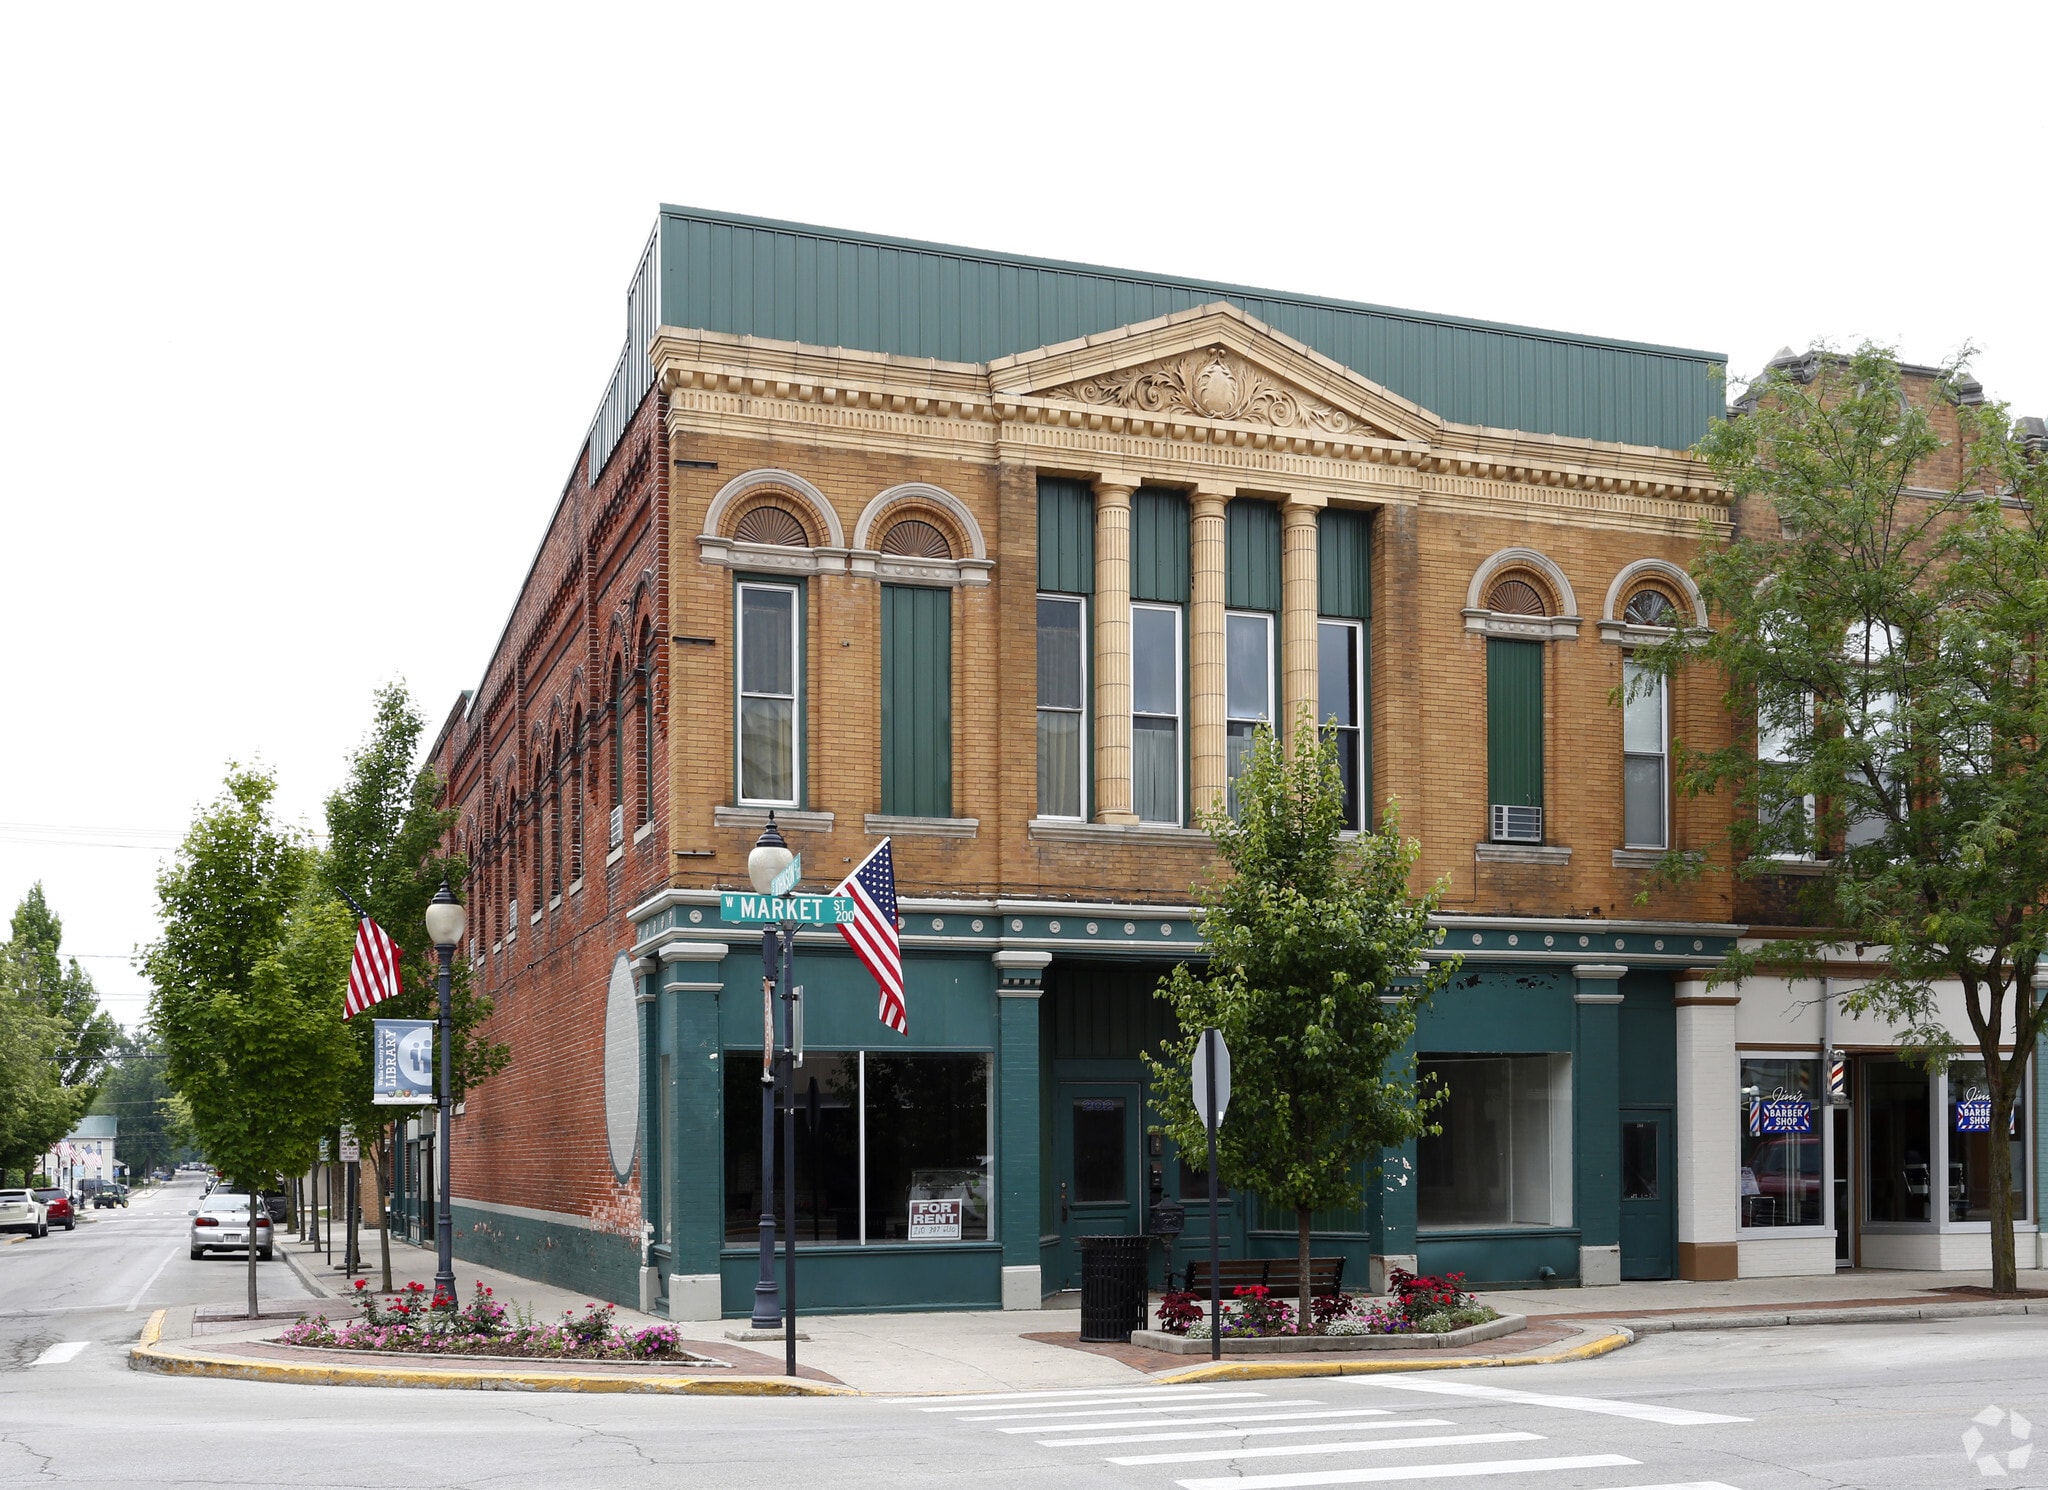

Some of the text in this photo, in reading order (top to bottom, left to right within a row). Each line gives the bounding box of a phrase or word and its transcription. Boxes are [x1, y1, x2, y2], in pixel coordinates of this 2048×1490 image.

[725, 896, 846, 920] W MARKET ST
[836, 911, 855, 922] 200
[385, 1029, 397, 1087] LIBRARY
[1769, 1086, 1803, 1109] Jim's
[1964, 1086, 1991, 1109] Jim
[1082, 1100, 1114, 1111] 202
[1770, 1109, 1803, 1117] BARBER
[1964, 1108, 1991, 1117] BARBE
[1775, 1117, 1798, 1126] SHOP
[918, 1203, 952, 1214] FOR
[913, 1214, 957, 1224] RENT
